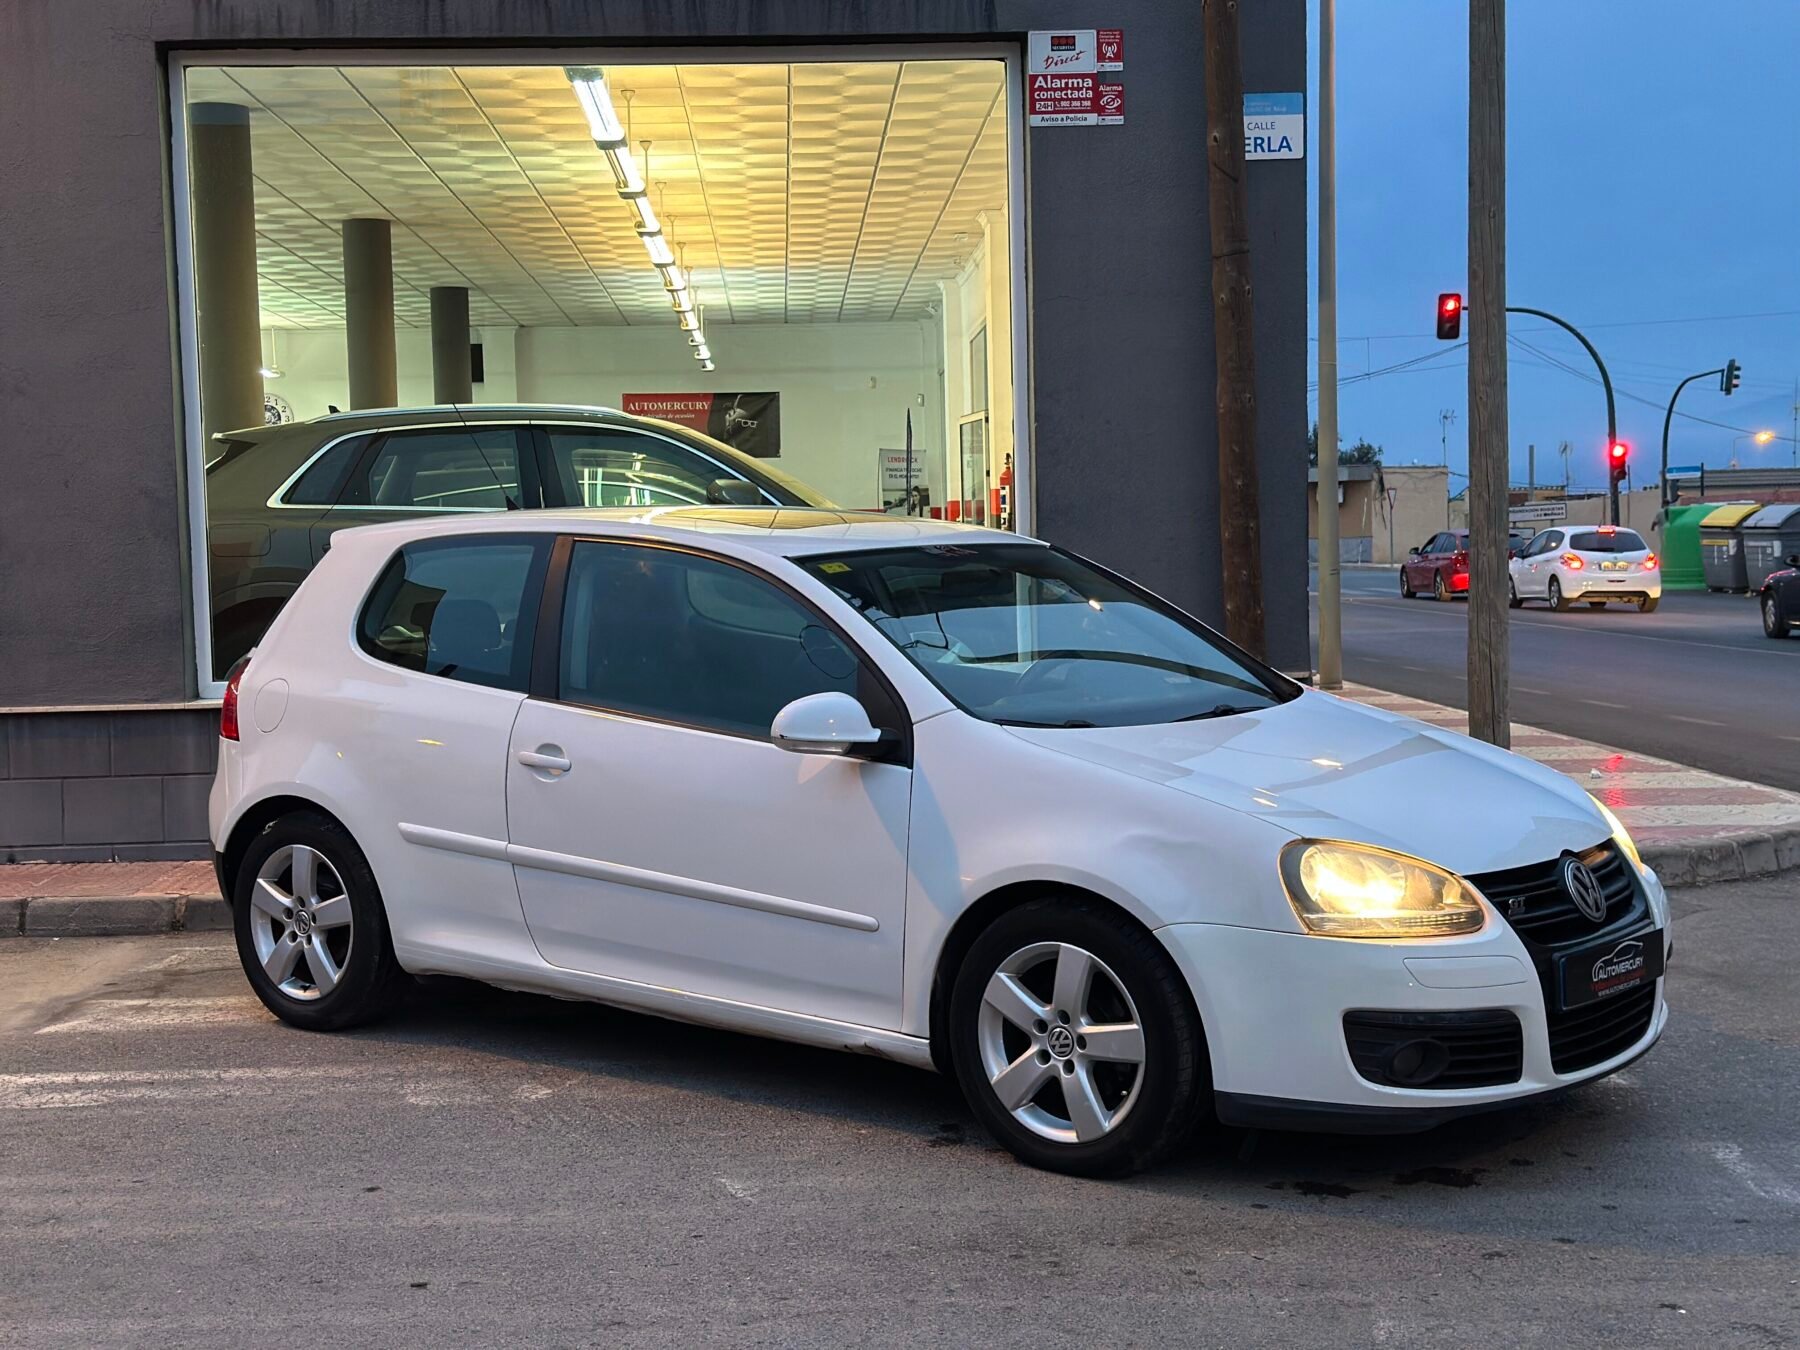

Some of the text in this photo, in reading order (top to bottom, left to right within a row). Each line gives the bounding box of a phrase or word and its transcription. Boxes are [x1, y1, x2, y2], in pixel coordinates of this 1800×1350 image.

[1043, 50, 1087, 70] Direct
[1034, 75, 1093, 89] Alarma
[1034, 88, 1093, 99] conectada
[1037, 102, 1053, 110] 24H
[1247, 121, 1276, 131] CALLE
[628, 401, 711, 411] AUTOMERCURY
[1599, 956, 1644, 980] AUTOMERCURY
